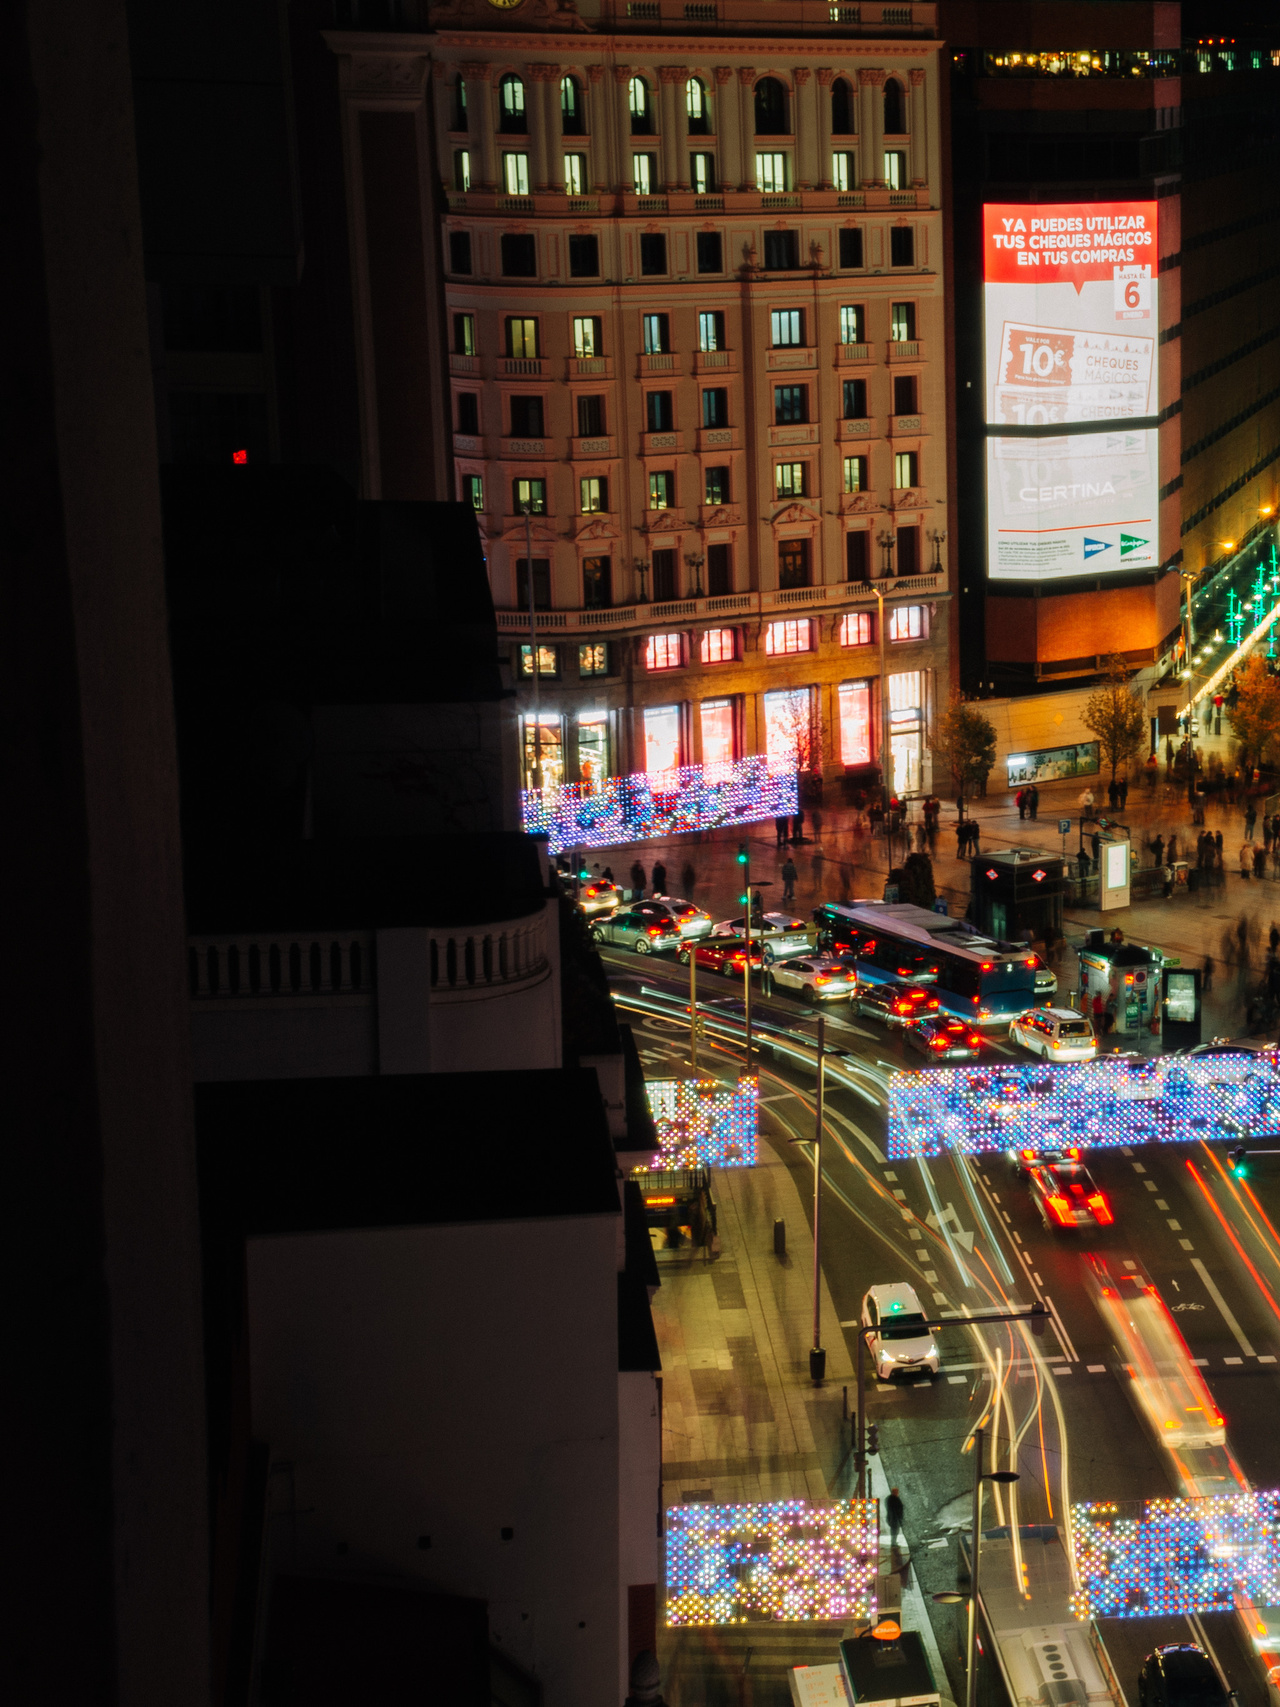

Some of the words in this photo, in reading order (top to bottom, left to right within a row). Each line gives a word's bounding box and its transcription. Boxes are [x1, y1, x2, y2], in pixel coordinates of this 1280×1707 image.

[1002, 218, 1027, 233] YA
[1031, 217, 1084, 233] PUEDES
[1086, 215, 1145, 231] UTILIZAR
[993, 234, 1026, 249] TUS
[1029, 234, 1091, 249] CHEQUES
[1093, 230, 1152, 247] MÁGICOS
[1017, 251, 1040, 266] EN
[1042, 250, 1069, 265] TUS
[1071, 248, 1135, 264] COMPRAS
[1124, 281, 1140, 308] 6
[1019, 343, 1065, 377] 10€
[1086, 355, 1139, 371] CHEQUES
[1019, 481, 1116, 502] CERTINA
